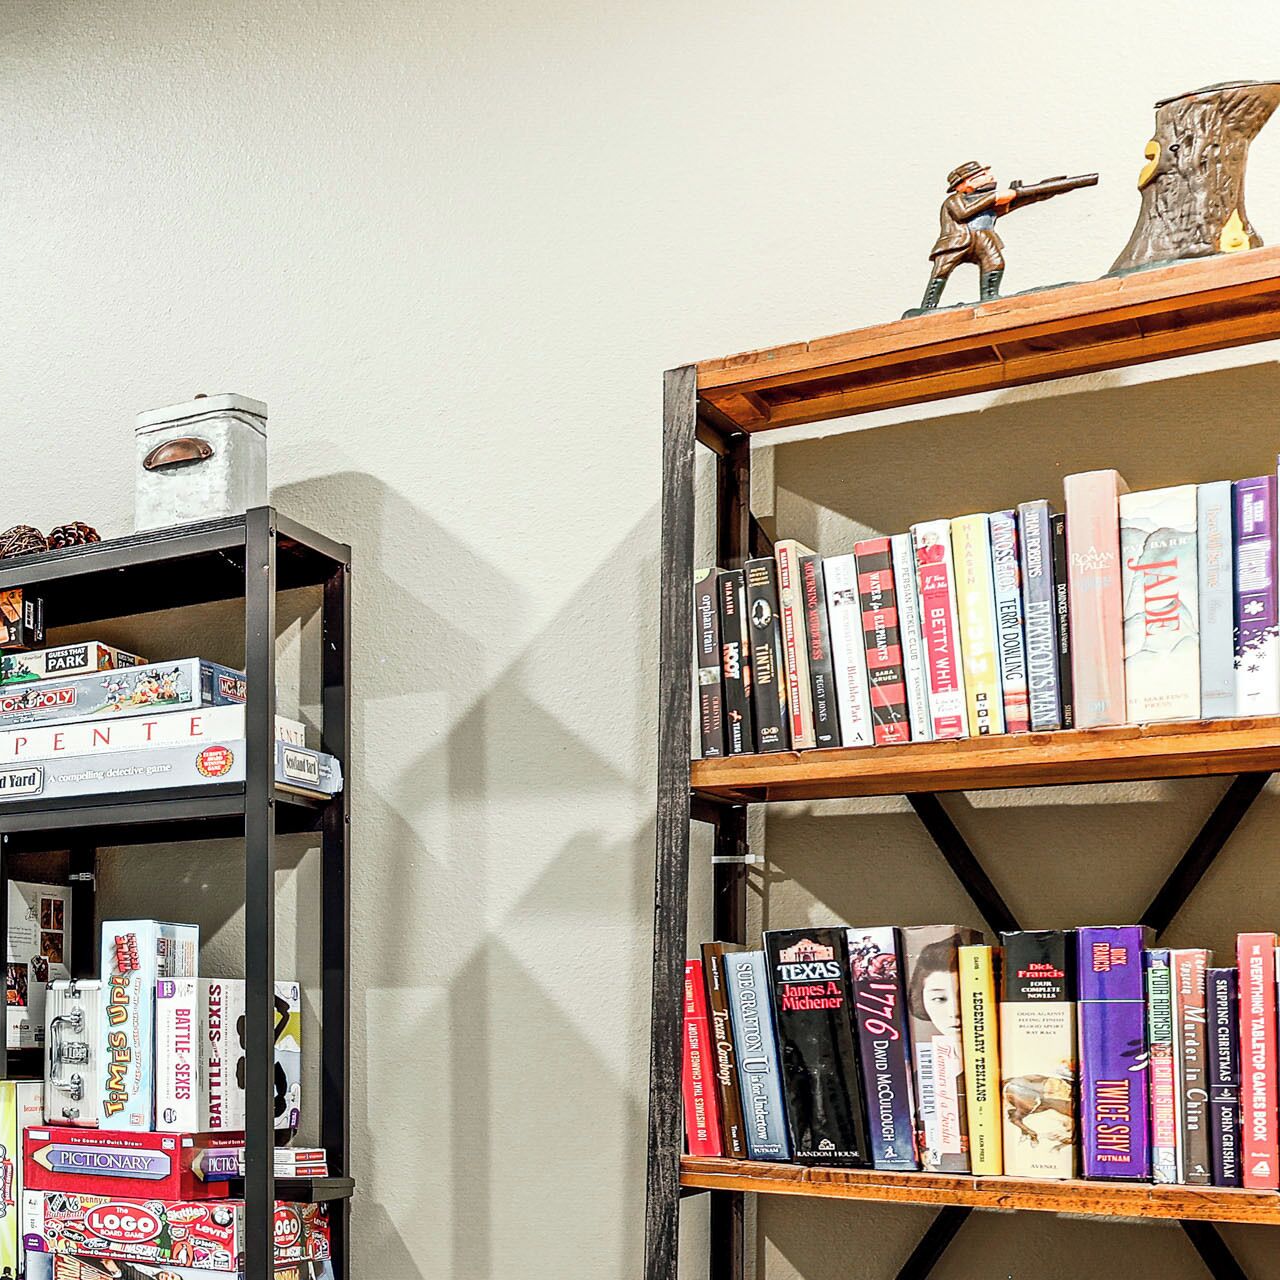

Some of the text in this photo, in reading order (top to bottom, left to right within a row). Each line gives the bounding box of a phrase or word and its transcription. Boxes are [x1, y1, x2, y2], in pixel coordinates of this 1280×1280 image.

[1071, 551, 1115, 566] ROMAN
[1001, 597, 1019, 632] TERRY
[1127, 556, 1181, 637] JADE
[702, 594, 717, 654] orphan train
[48, 655, 85, 671] PARK
[723, 642, 740, 679] HOOT
[756, 643, 771, 685] TINTIN
[1003, 632, 1024, 680] DOWLING
[15, 717, 204, 755] PENTE
[9, 773, 36, 790] Yard
[58, 769, 104, 783] compelling
[106, 766, 143, 778] detective
[146, 764, 171, 776] game
[115, 935, 130, 972] TITLE
[777, 962, 841, 981] TEXAS
[1029, 963, 1054, 971] Dick
[1093, 942, 1109, 972] FRANCIS
[1110, 948, 1127, 965] DICK
[782, 982, 842, 997] James A.
[1017, 970, 1064, 978] Francis
[737, 963, 763, 1052] SUE GRAFTON
[782, 996, 843, 1011] Michener
[856, 983, 899, 1040] 1776
[1216, 980, 1231, 1081] SKIPPING CHRISTMAS
[175, 1008, 190, 1100] BATTLE SEXES
[209, 984, 222, 1128] BATTLE SEXES
[1250, 957, 1267, 1141] EVERYTHING TABLETOP GAMES BOOK
[688, 1023, 707, 1141] 100 MISTAKES THAT CHANGED HISTORY
[1184, 1005, 1208, 1130] Murder in China
[1096, 1079, 1131, 1153] TWICE SHY
[1097, 1155, 1130, 1163] PUTNAM
[1221, 1106, 1234, 1178] JOHN GRISHAM
[60, 1151, 152, 1171] PICTIONARY
[92, 1213, 155, 1233] LOGO
[167, 1205, 207, 1221] Skittles
[100, 1230, 123, 1238] BOARD
